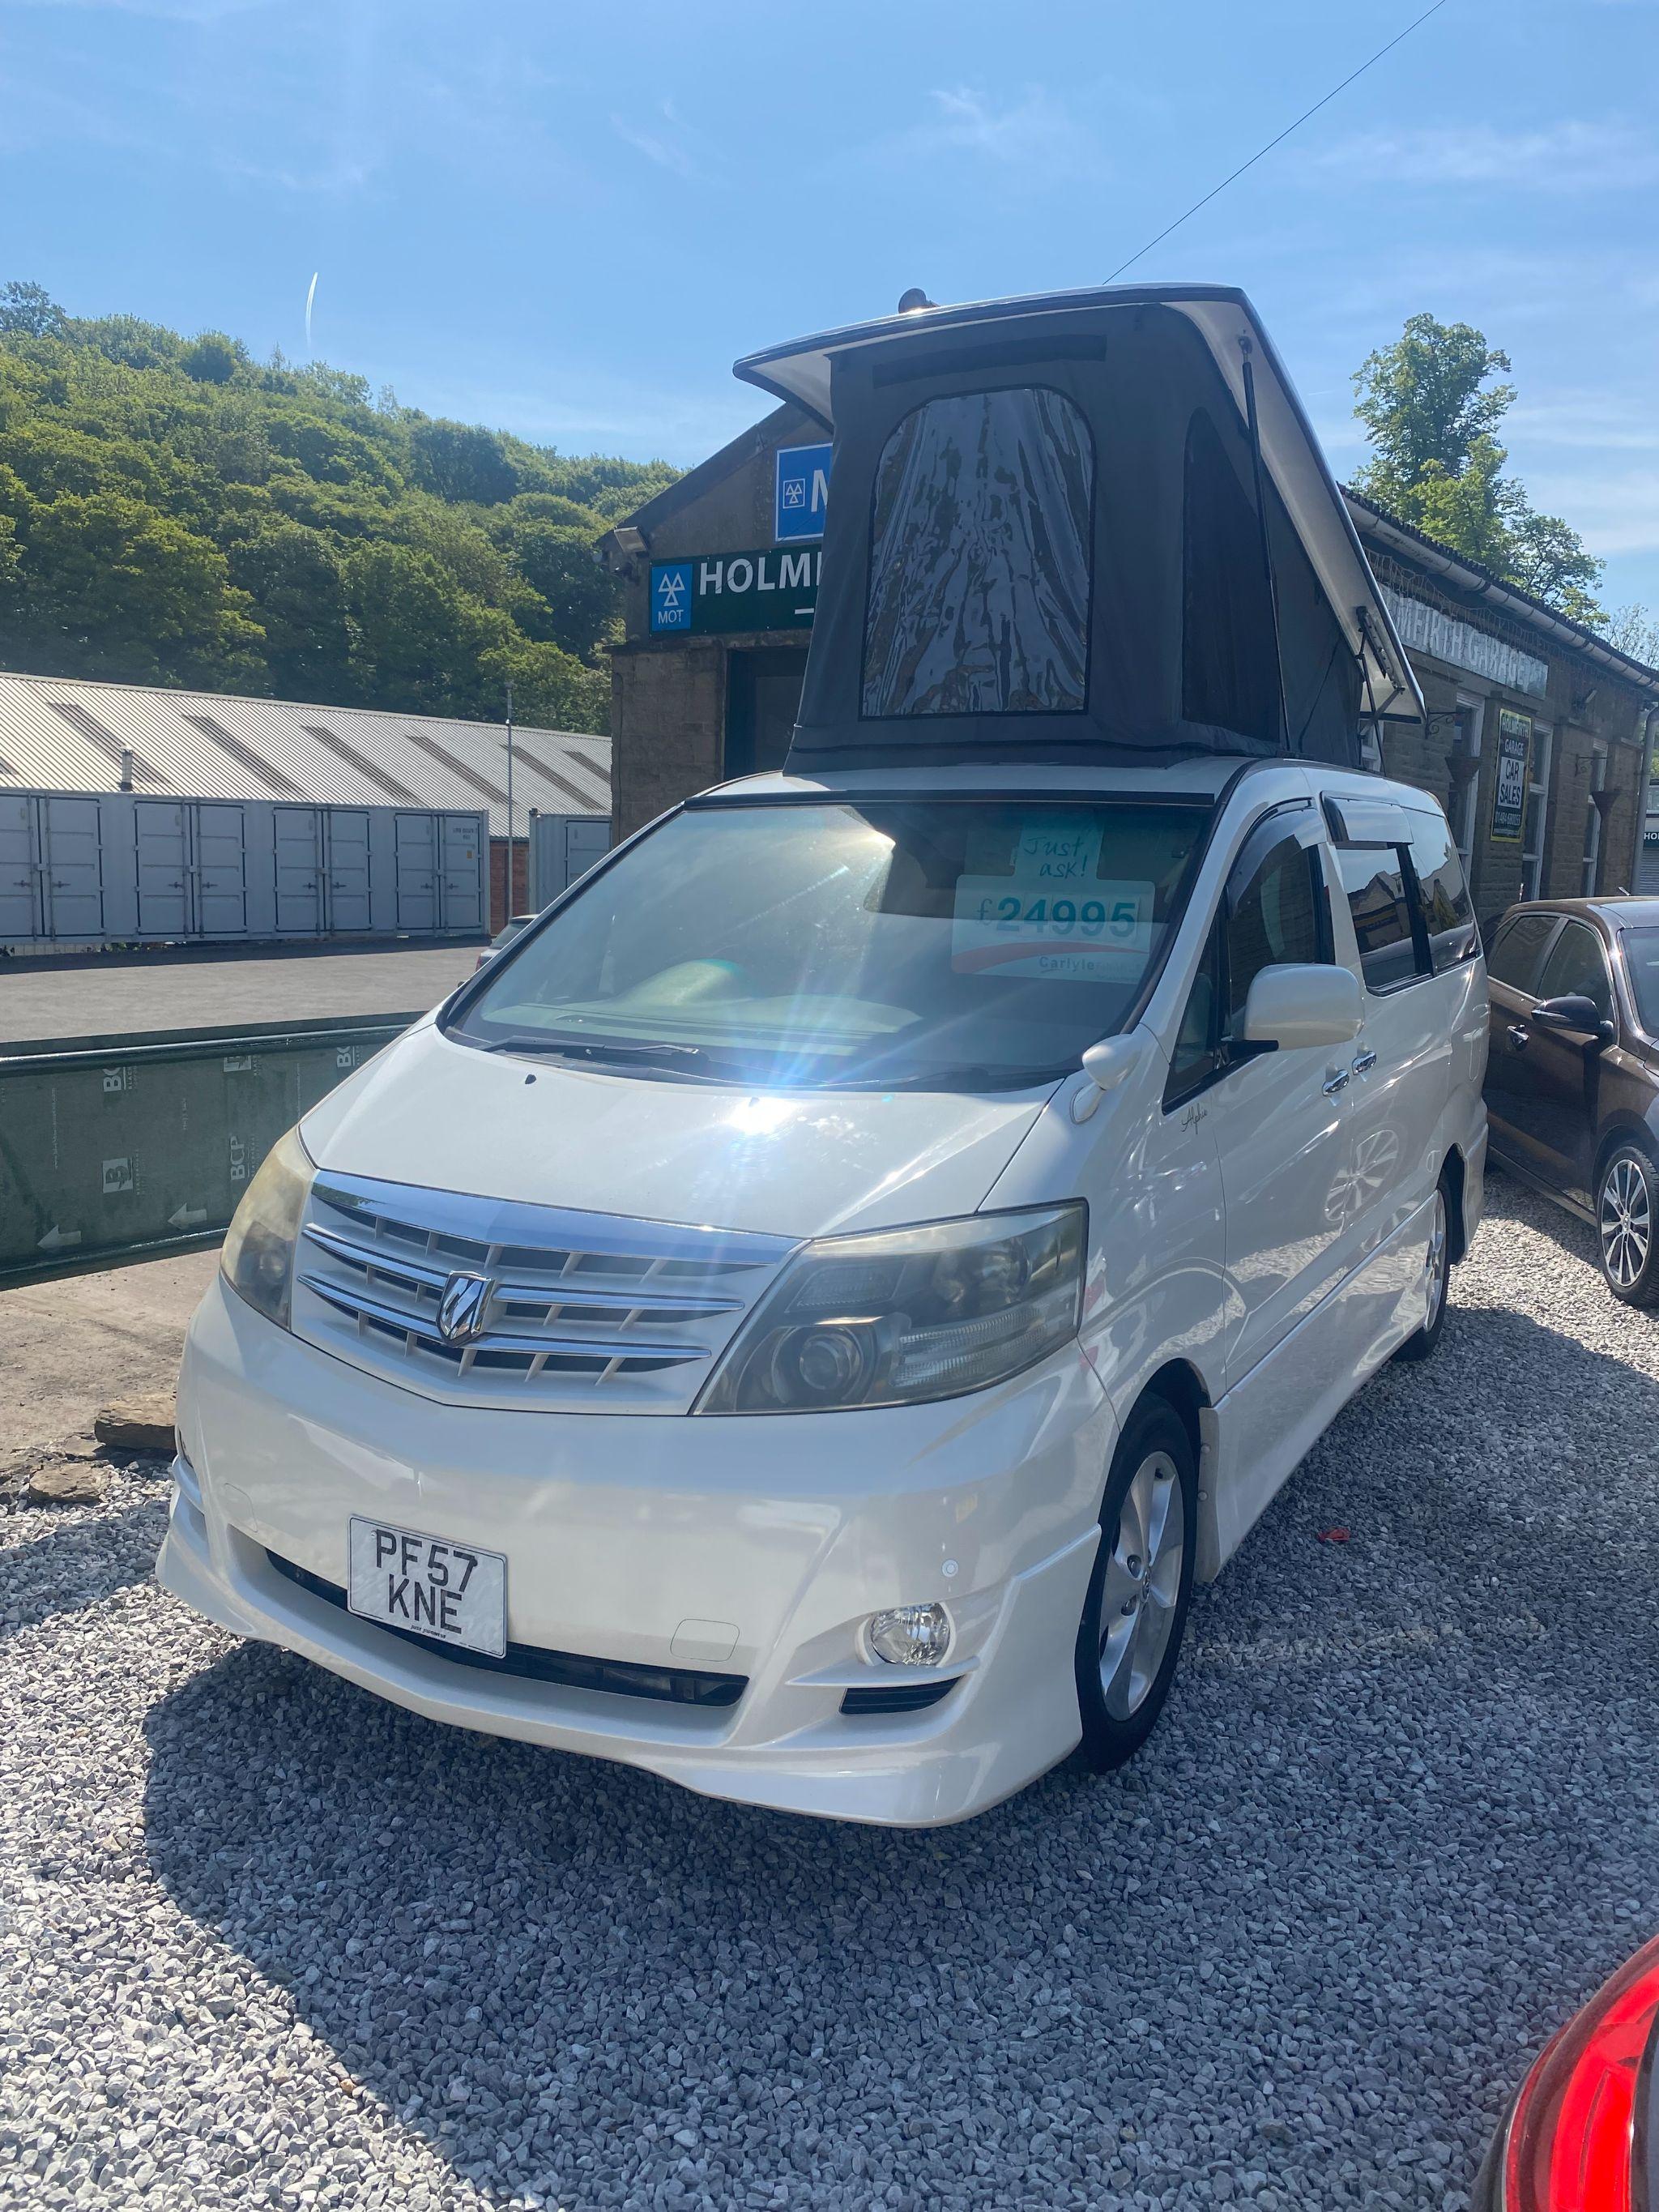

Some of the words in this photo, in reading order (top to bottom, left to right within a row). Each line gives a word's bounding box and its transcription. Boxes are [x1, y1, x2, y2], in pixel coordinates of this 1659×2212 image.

[658, 609, 684, 625] MOT
[1504, 738, 1524, 756] GARAGE
[1506, 760, 1520, 782] CAR
[1499, 784, 1521, 805] SALES
[1023, 835, 1084, 856] Just
[1039, 853, 1088, 879] ask!
[1038, 956, 1094, 971] Carlyle
[230, 1134, 245, 1180] BCP
[376, 1529, 478, 1592] PF57
[389, 1574, 463, 1635] KNE
